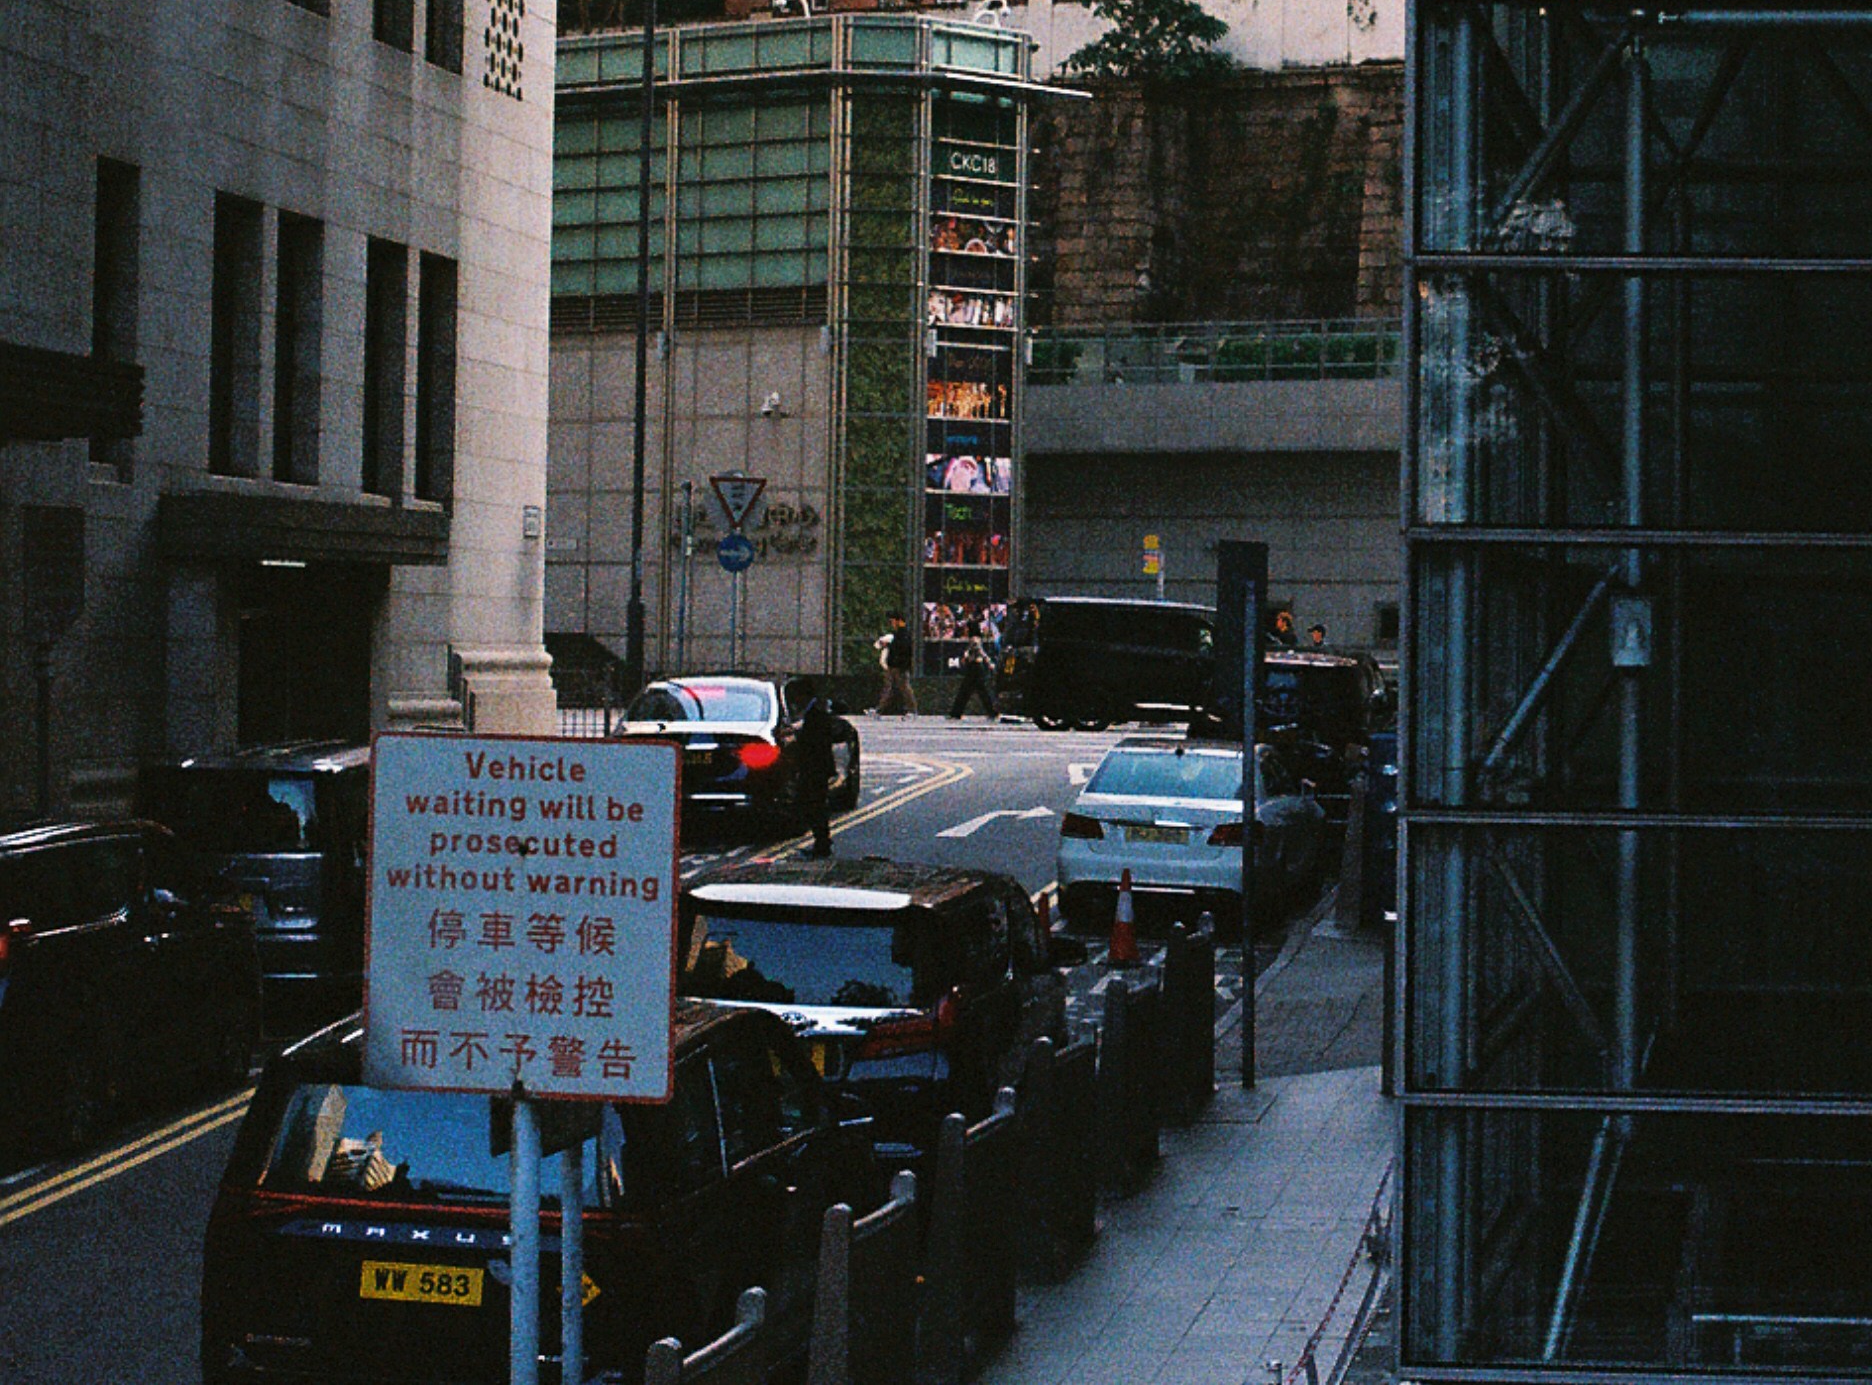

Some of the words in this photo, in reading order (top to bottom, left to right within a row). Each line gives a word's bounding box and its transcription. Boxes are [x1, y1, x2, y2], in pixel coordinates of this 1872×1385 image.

[950, 151, 997, 174] CKC18
[464, 750, 586, 783] Vehicle
[405, 790, 527, 822] waiting
[539, 794, 595, 821] will
[606, 796, 644, 822] be
[430, 830, 618, 859] prosecuted
[386, 863, 515, 892] without
[527, 871, 659, 902] warning
[428, 908, 616, 957] 停車等候
[427, 969, 614, 1018] 會被檢控
[400, 1028, 637, 1081] 而不予警告
[375, 1267, 408, 1293] WW
[419, 1271, 471, 1297] 583
